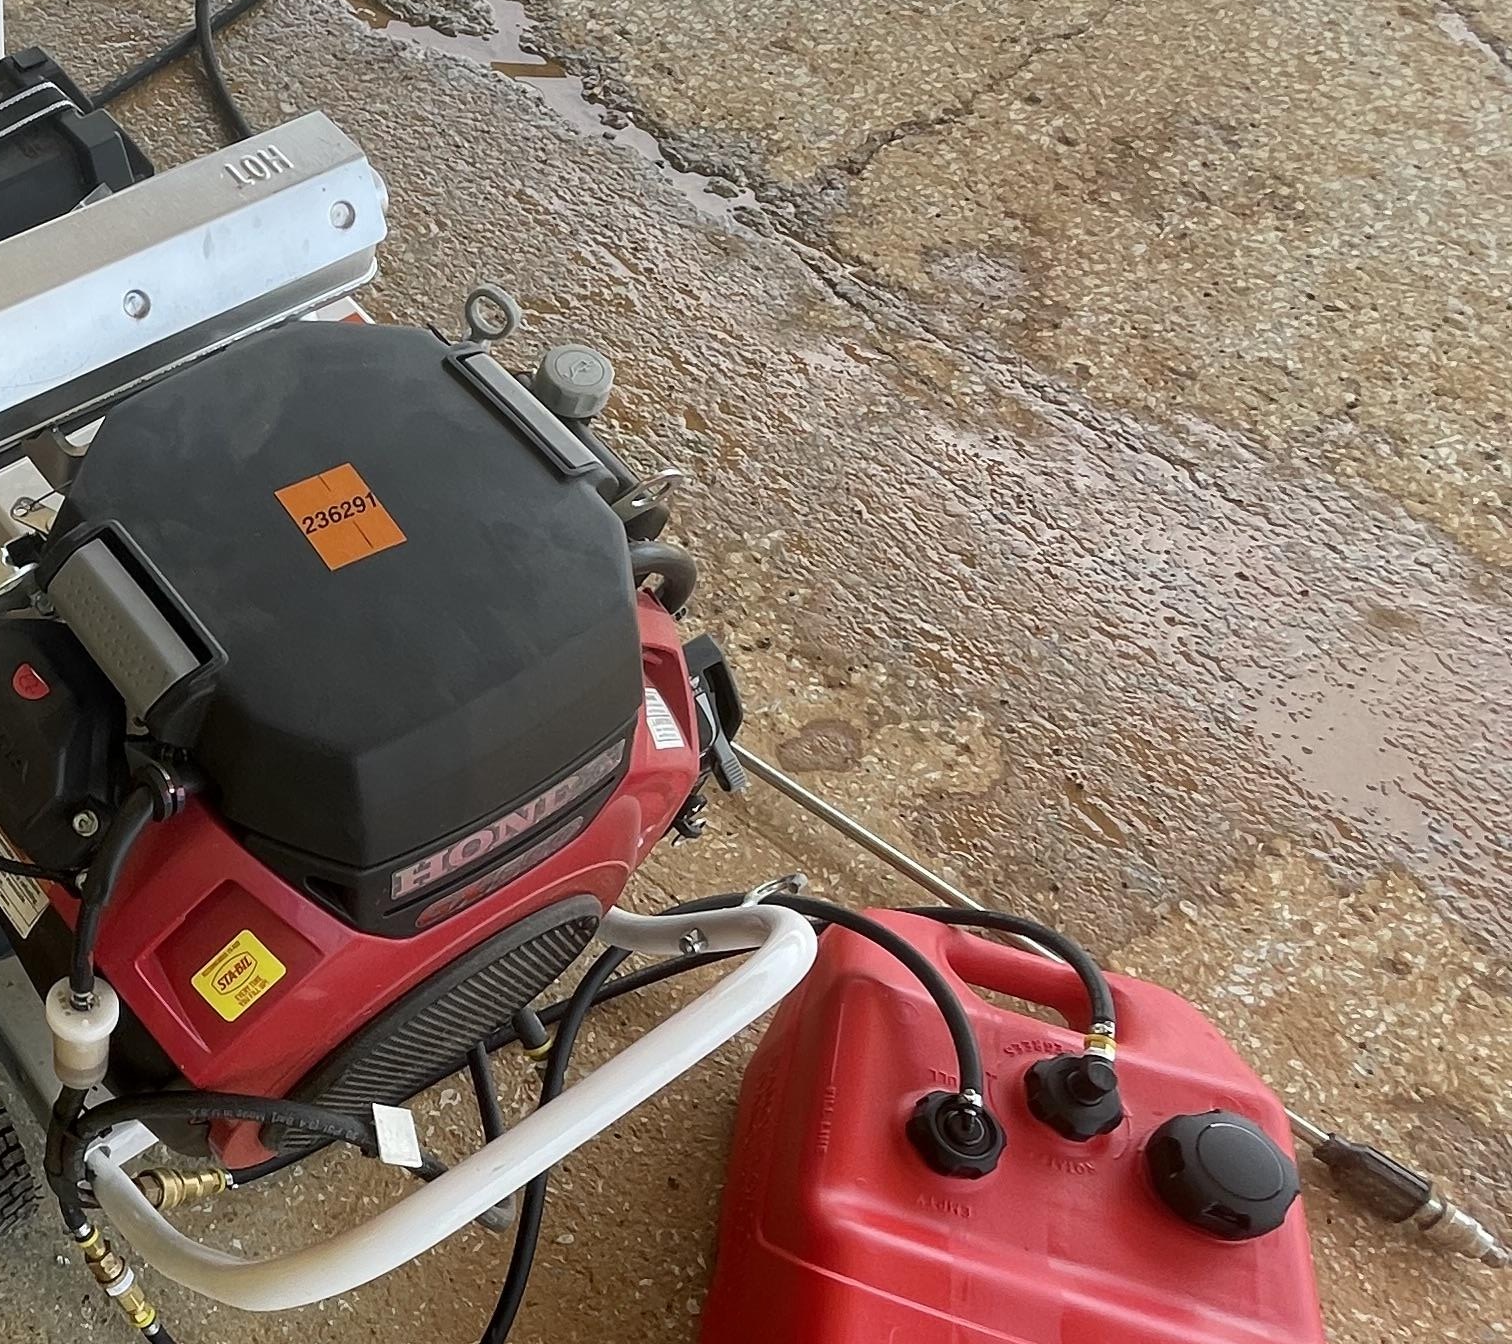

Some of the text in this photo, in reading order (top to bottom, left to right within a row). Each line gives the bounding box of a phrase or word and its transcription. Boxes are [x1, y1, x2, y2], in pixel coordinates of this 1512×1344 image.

[222, 144, 294, 191] HOT
[301, 491, 379, 535] 236291
[216, 956, 252, 990] STA-BIL
